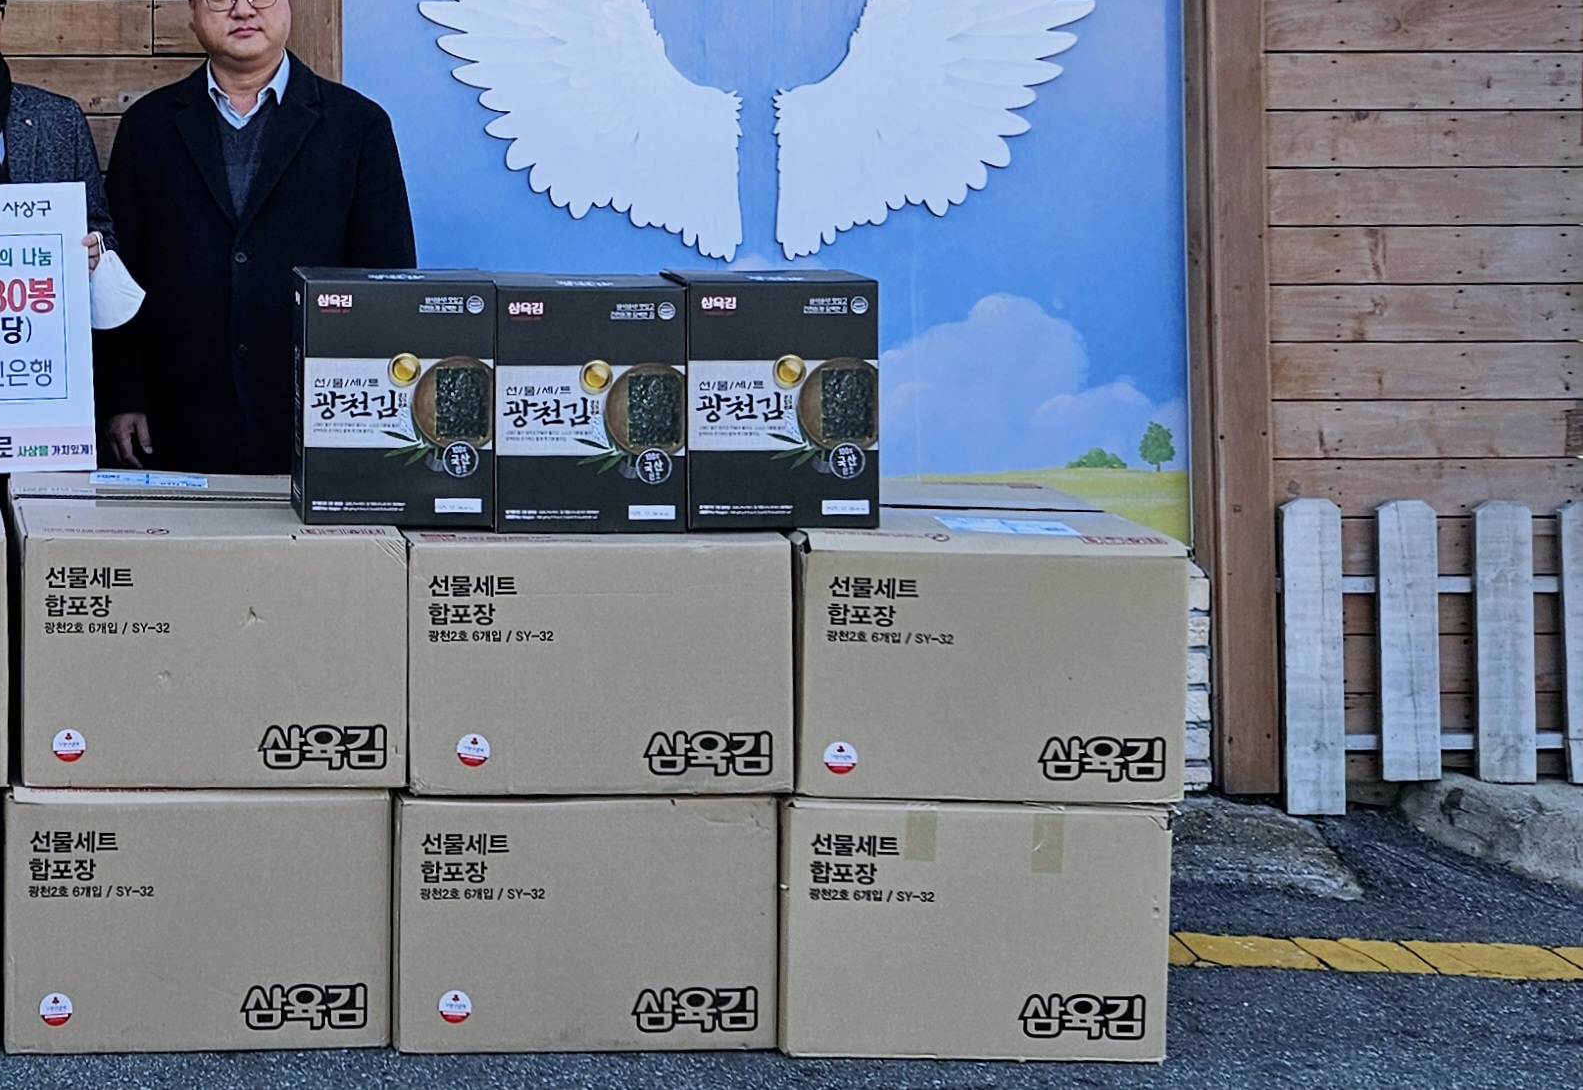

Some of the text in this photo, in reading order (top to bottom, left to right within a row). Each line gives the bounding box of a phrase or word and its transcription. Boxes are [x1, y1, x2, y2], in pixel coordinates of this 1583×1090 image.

[3, 200, 52, 218] 사상구
[22, 247, 52, 267] 나눔
[317, 294, 353, 308] 삼육김
[507, 301, 544, 316] 삼육김
[700, 296, 737, 311] 삼육김
[311, 390, 398, 420] 광천김
[502, 396, 590, 427] 광천김
[695, 393, 783, 423] 광천김
[17, 446, 48, 457] 사상을
[46, 567, 133, 589] 선물세트
[429, 575, 517, 597] 선물세트
[829, 577, 918, 599] 선물세트
[45, 595, 112, 617] 합포장
[429, 603, 495, 625] 합포장
[828, 603, 896, 627] 합포장
[45, 622, 169, 634] 광천2호 6개입 SY-32
[429, 630, 553, 642] 광천2호 6개입 SY-32
[827, 631, 953, 644] 광천2호 6개입 SY-32
[258, 724, 387, 770] 삼육김
[643, 731, 773, 776] 삼육김
[1038, 736, 1166, 782] 삼육김
[30, 831, 118, 853] 선물세트
[421, 833, 509, 855] 선물세트
[811, 834, 899, 857] 선물세트
[29, 858, 96, 881] 합포장
[421, 861, 488, 883] 합포장
[810, 861, 877, 885] 합포장
[29, 886, 154, 897] 광천2호 6개입 SY-32
[421, 888, 545, 900] 광천2호 6개입 SY-32
[810, 888, 934, 902] 광천2호 6개입 SY-32
[240, 983, 368, 1030] 삼육김
[631, 986, 758, 1033] 삼육김
[1018, 993, 1146, 1040] 삼육김
